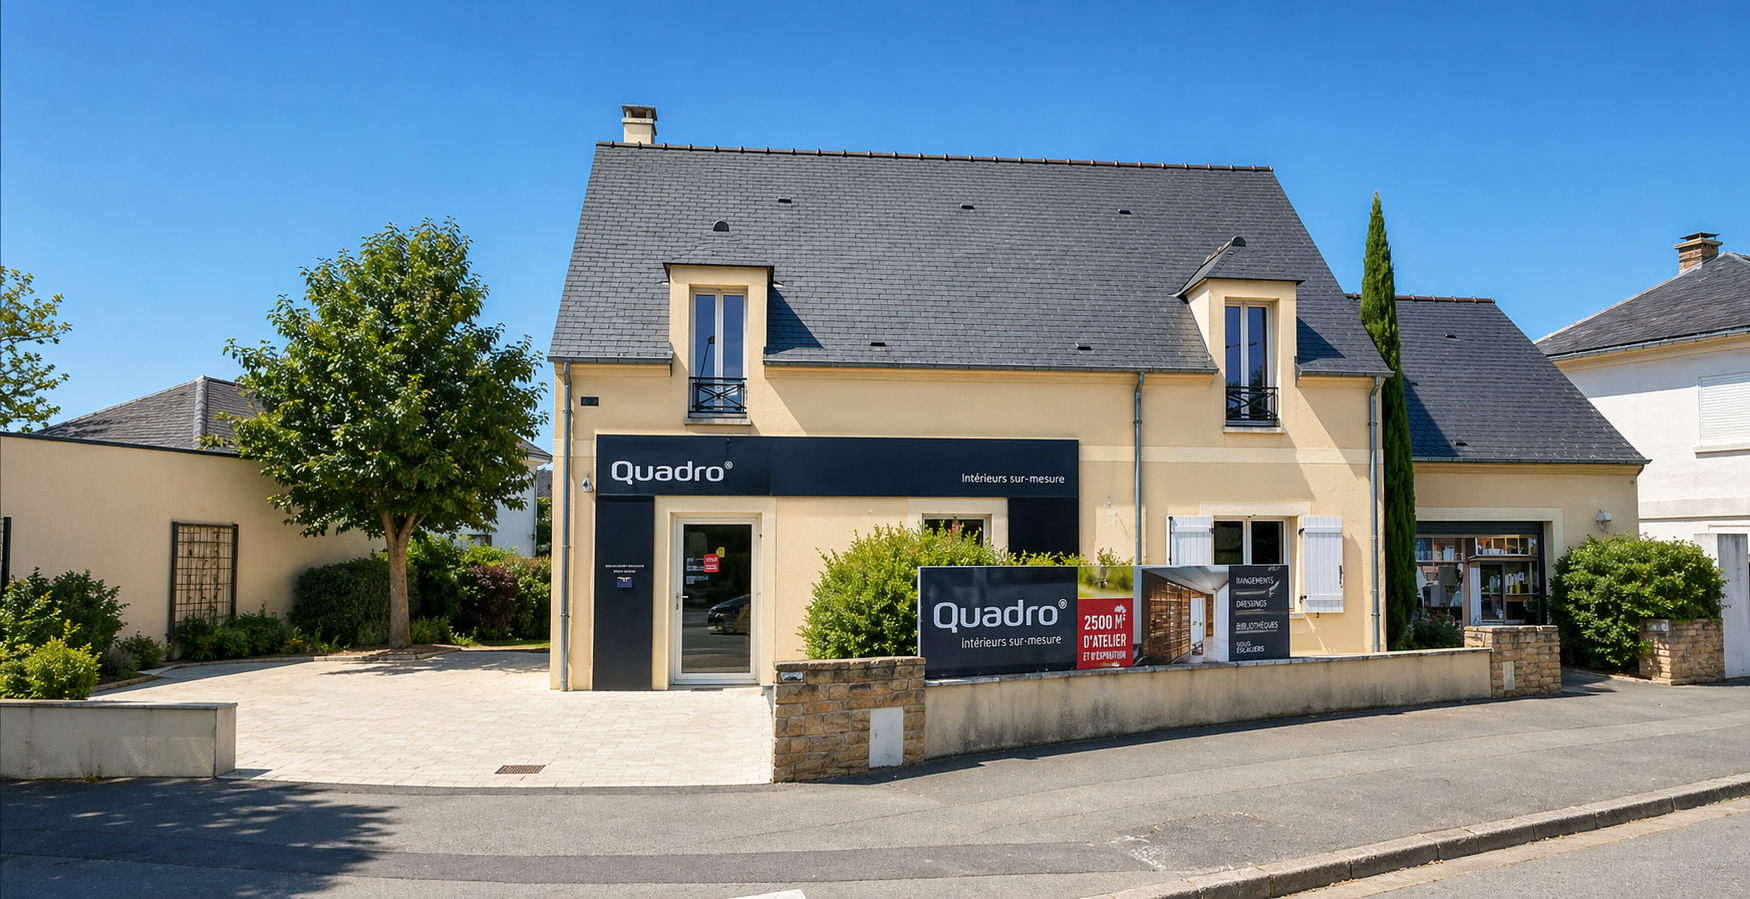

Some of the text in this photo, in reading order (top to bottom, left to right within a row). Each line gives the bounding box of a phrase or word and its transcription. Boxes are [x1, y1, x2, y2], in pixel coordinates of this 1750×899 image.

[961, 473, 1065, 484] Intérieurs sur-mesure
[1084, 615, 1112, 630] 2500
[1009, 635, 1062, 647] sur-mesure
[1083, 633, 1127, 648] D'ATELIER
